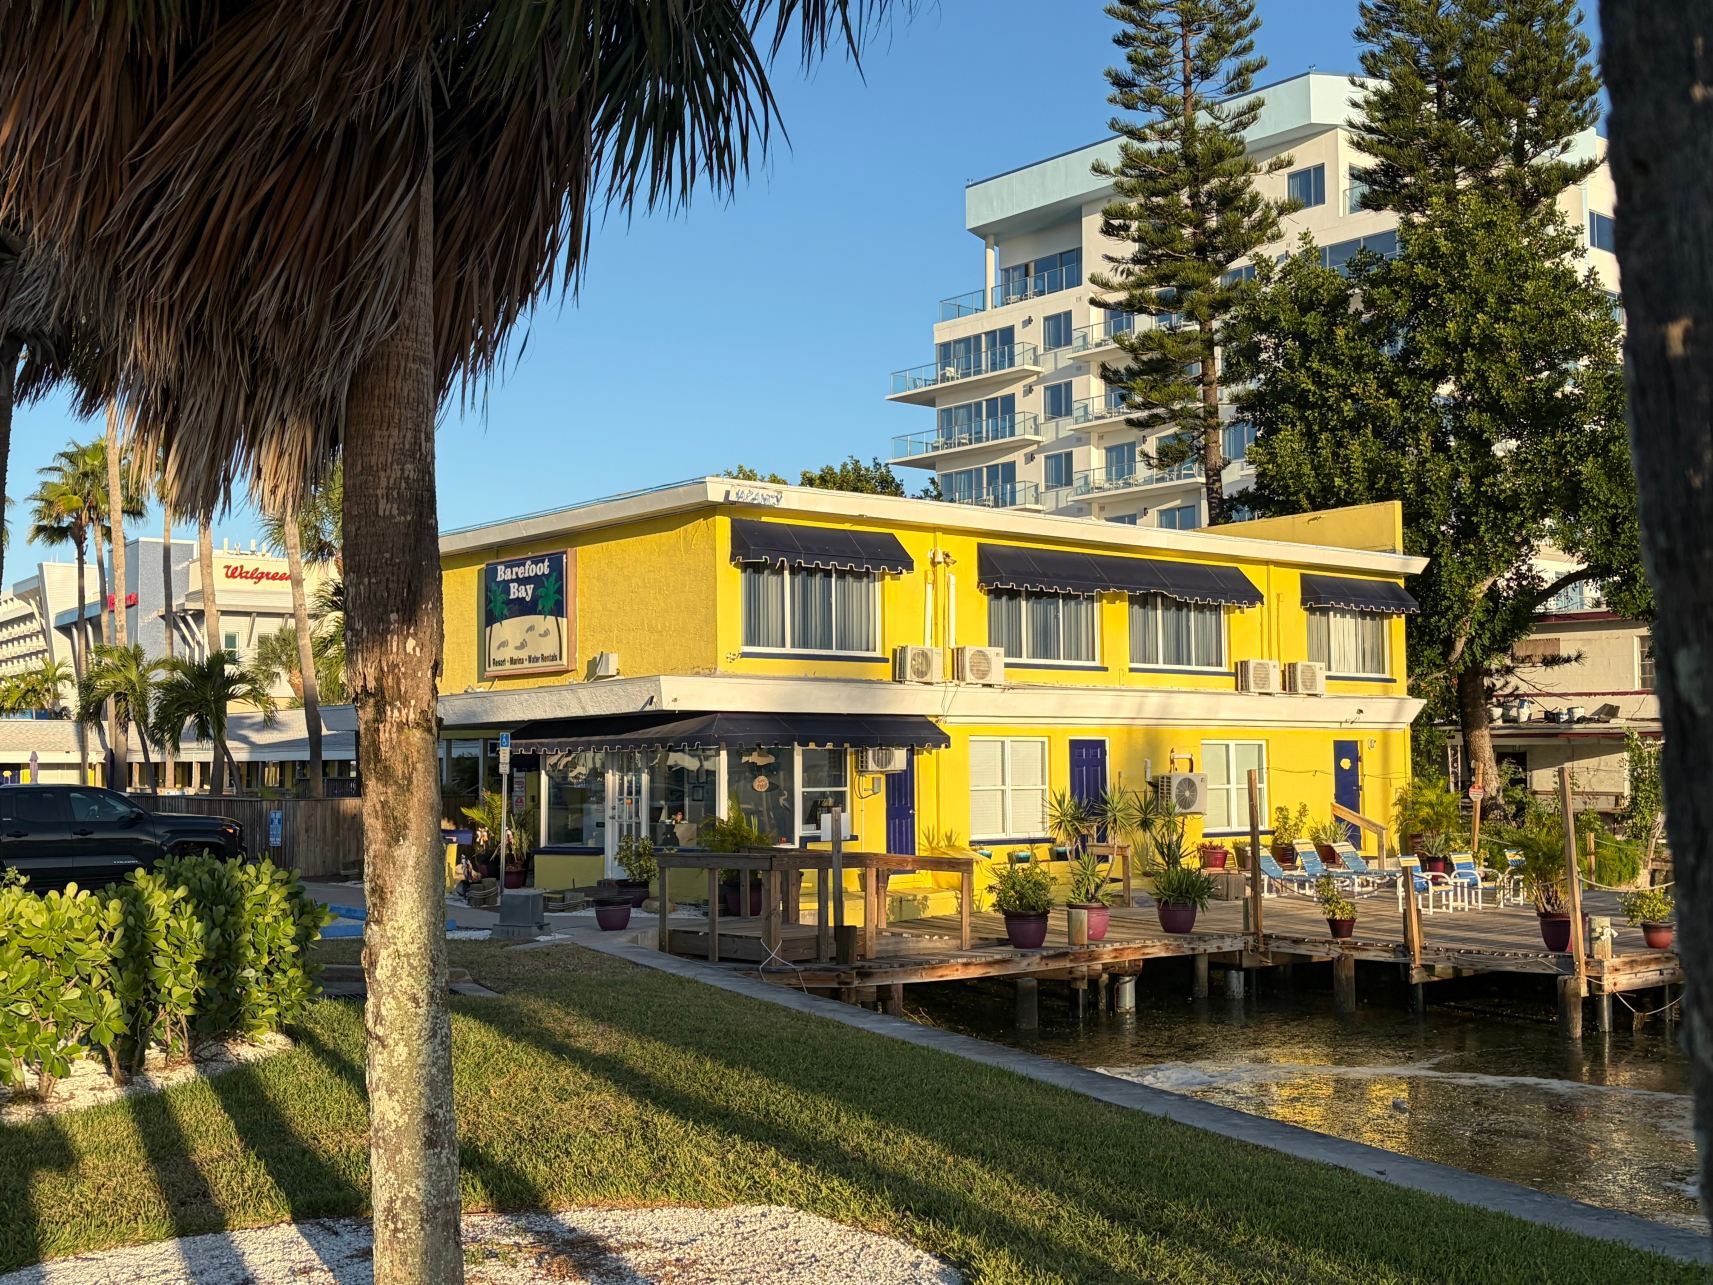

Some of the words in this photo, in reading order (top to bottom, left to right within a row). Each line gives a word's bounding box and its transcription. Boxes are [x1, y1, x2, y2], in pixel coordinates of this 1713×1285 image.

[223, 564, 305, 585] Walgree
[496, 558, 549, 581] Barefoot
[509, 583, 534, 601] Bay
[510, 656, 524, 665] Marina
[541, 653, 557, 662] Rentals
